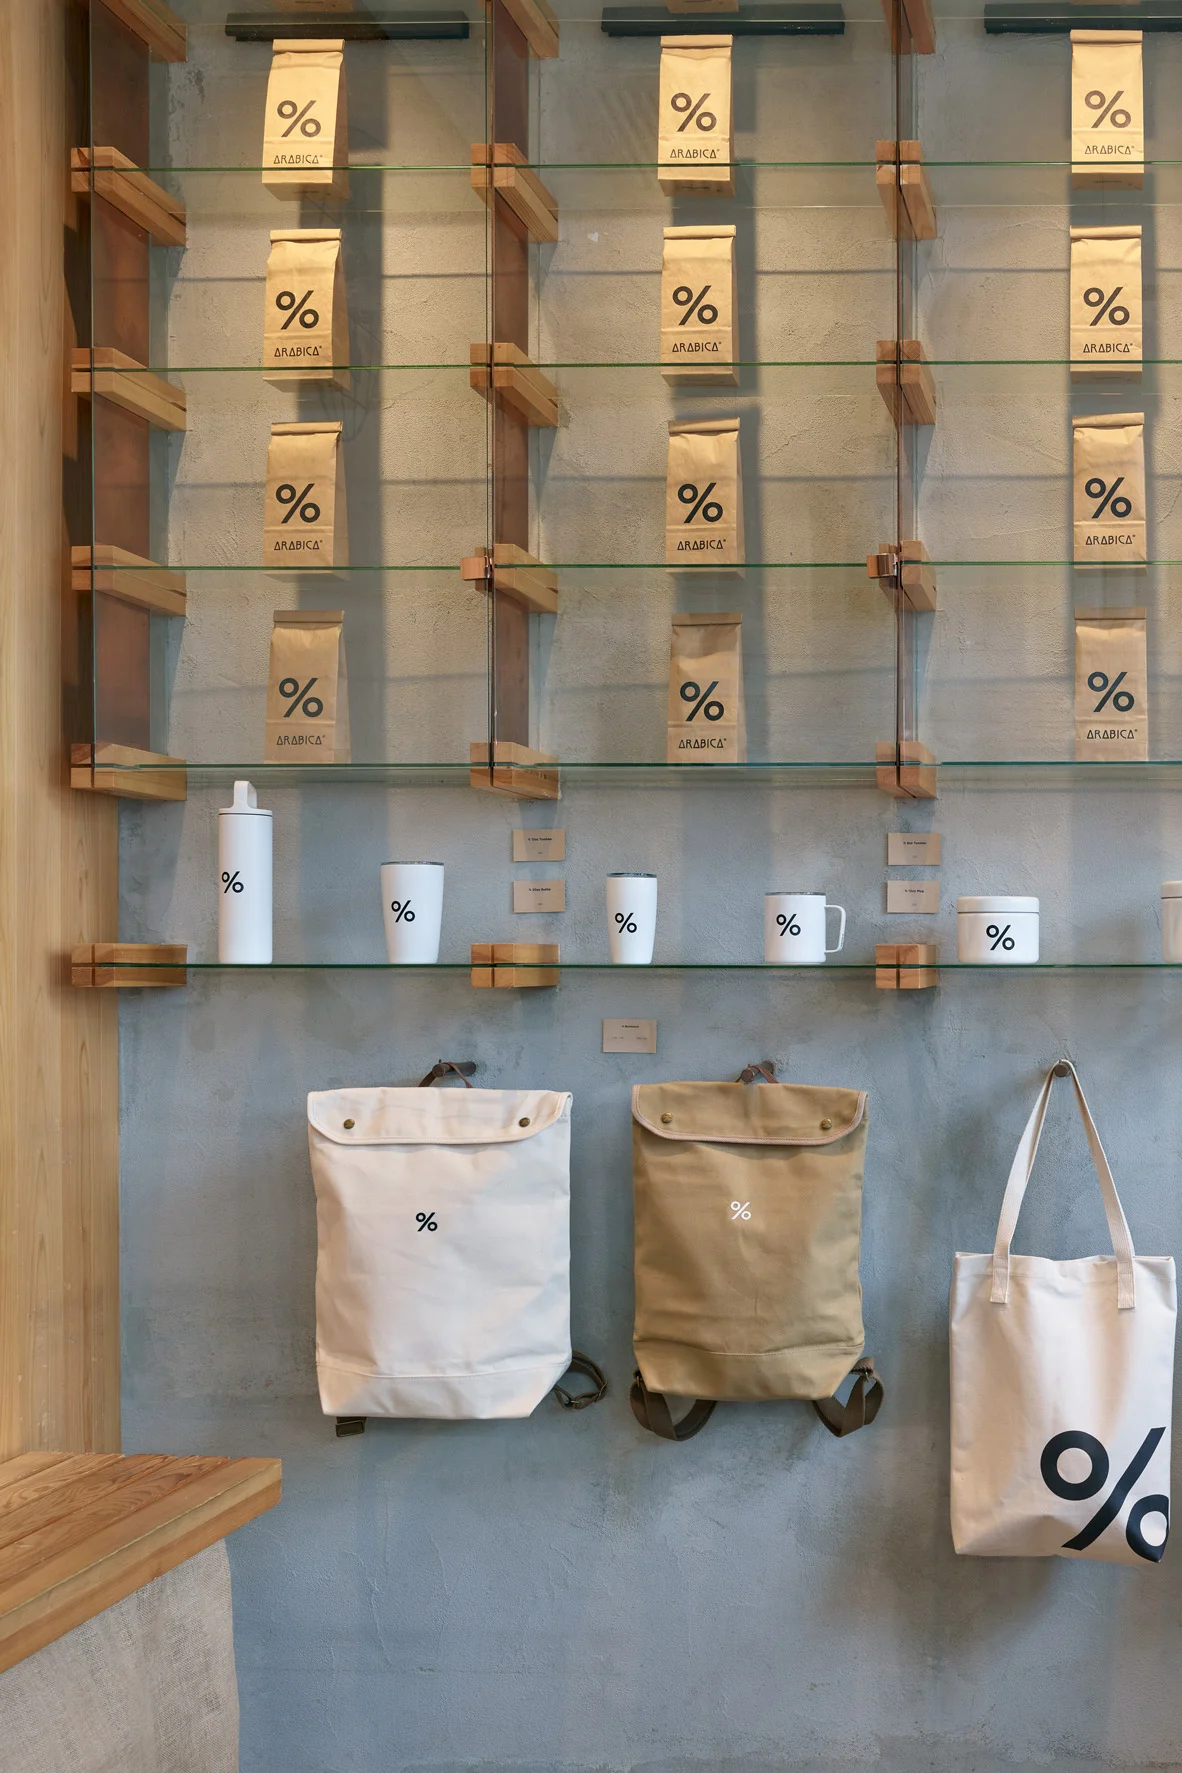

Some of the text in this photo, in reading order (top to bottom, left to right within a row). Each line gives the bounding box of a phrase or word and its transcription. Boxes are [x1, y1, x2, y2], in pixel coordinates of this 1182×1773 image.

[277, 100, 321, 137] %
[671, 93, 716, 132] %
[1085, 90, 1131, 128] %
[273, 154, 320, 165] ARABICA
[669, 148, 717, 159] ARABICA
[1084, 144, 1132, 155] ARABICA
[276, 290, 319, 330] %
[673, 285, 718, 326] %
[1083, 287, 1130, 326] %
[273, 345, 320, 358] ARABICA
[671, 341, 719, 353] ARABICA
[1082, 342, 1131, 354] ARABICA
[276, 483, 320, 524] %
[678, 483, 723, 523] %
[1085, 477, 1132, 519] %
[273, 540, 320, 551] ARABICA
[676, 539, 724, 551] ARABICA
[1085, 534, 1133, 546] ARABICA
[279, 678, 323, 717] %
[680, 681, 724, 721] %
[1088, 672, 1134, 712] %
[276, 735, 323, 746] ARABICA
[678, 738, 724, 749] ARABICA
[1086, 729, 1135, 740] ARABICA
[222, 871, 244, 893] %
[392, 900, 415, 922] %
[615, 913, 637, 933] %
[776, 914, 801, 936] %
[986, 925, 1015, 950] %
